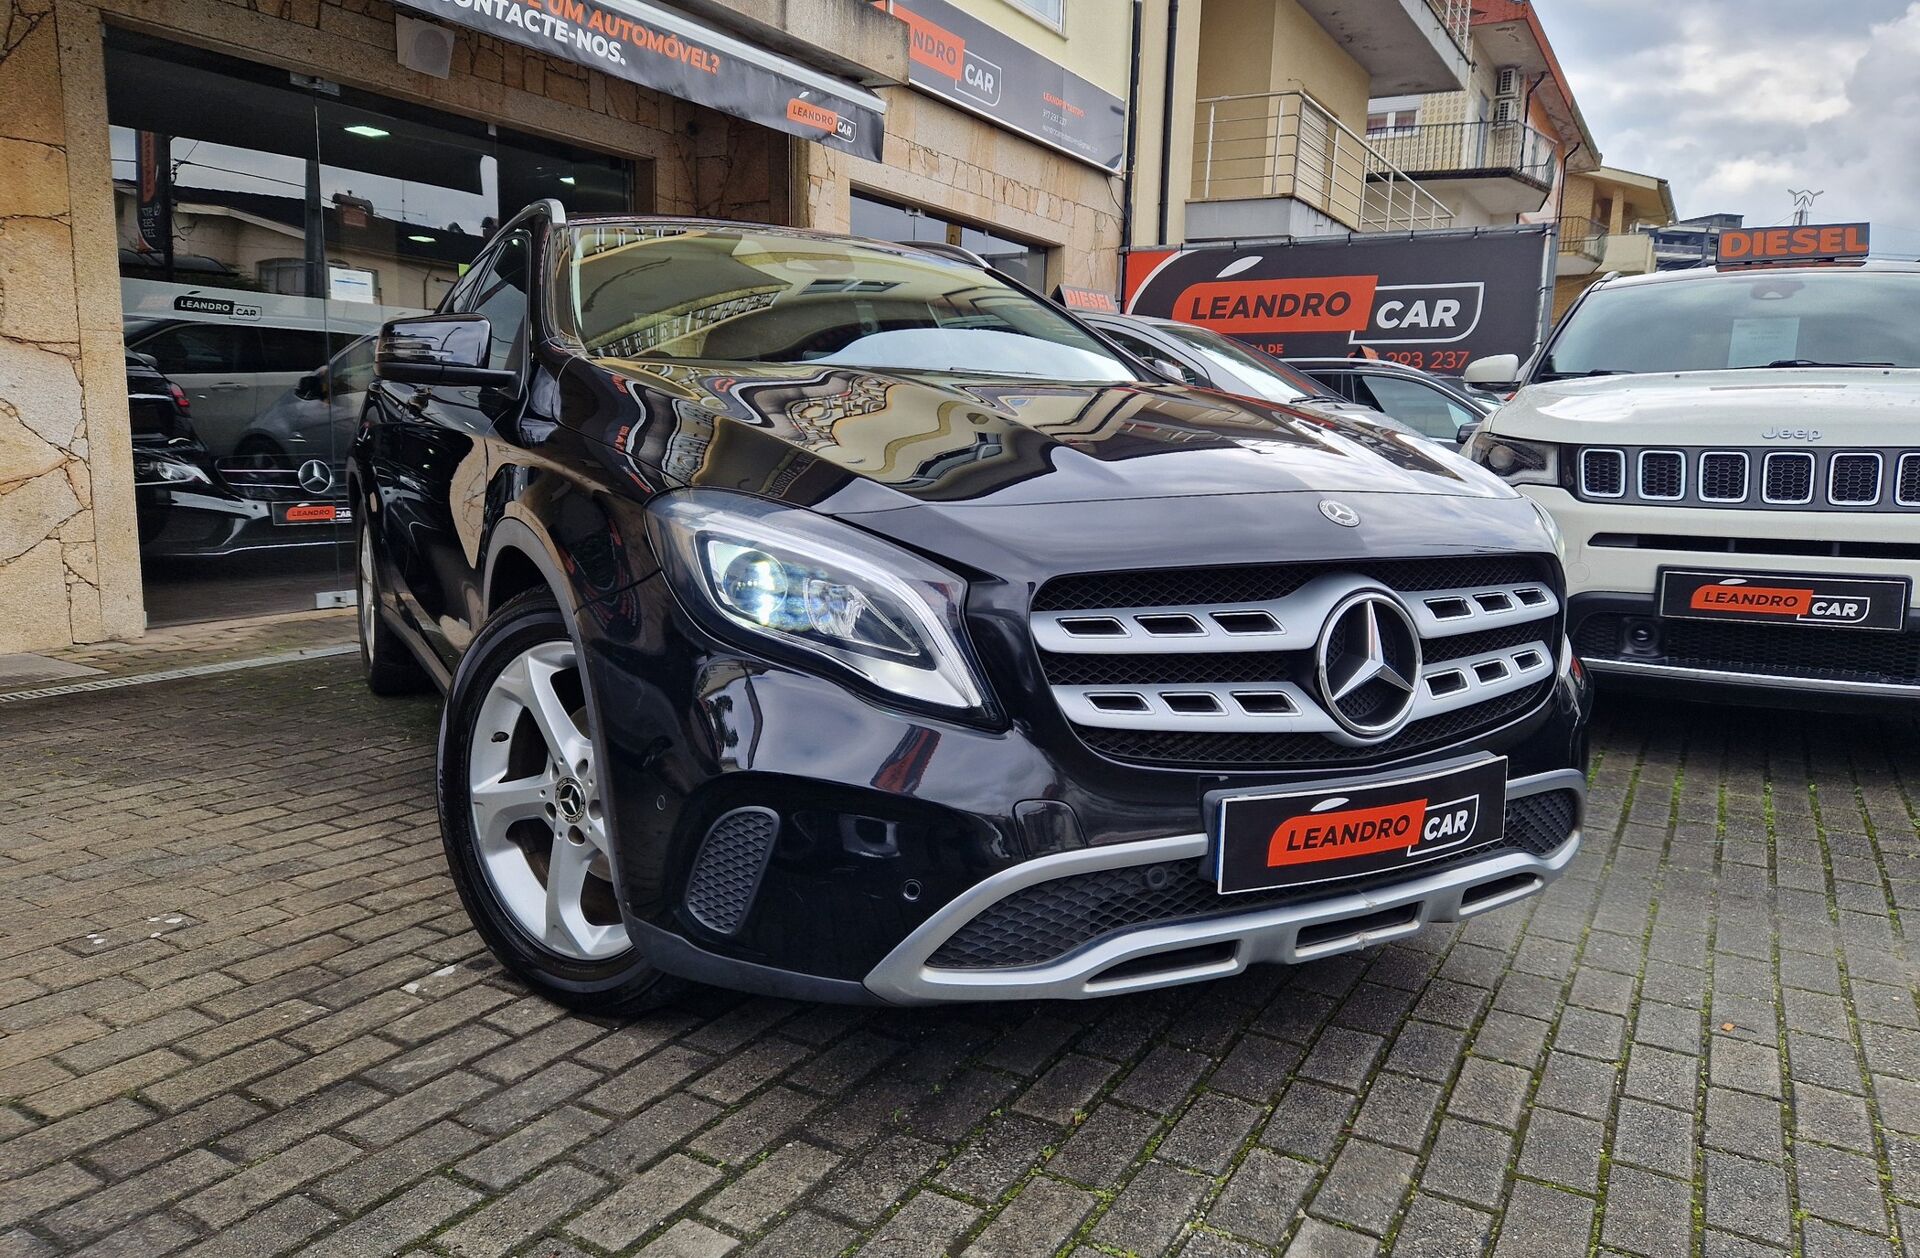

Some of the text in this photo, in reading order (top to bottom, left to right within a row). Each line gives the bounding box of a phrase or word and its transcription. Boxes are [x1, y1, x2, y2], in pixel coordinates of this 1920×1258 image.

[445, 0, 626, 65] NTACTE-NOS.
[548, 0, 721, 74] UM AUTOMÓVEL?
[964, 63, 995, 94] CAR
[792, 104, 852, 137] LEANDRO CAR
[1720, 227, 1869, 258] DIESEL
[180, 299, 257, 317] LEANDRO CAR
[1065, 288, 1116, 310] DIESEL
[1190, 291, 1461, 329] LEANDRO CAR
[1268, 343, 1284, 354] DE
[1430, 351, 1471, 369] 237
[1762, 427, 1822, 441] Jeep
[291, 508, 330, 517] LEANDRO
[1704, 591, 1859, 617] LEANDRO CAR
[1287, 809, 1469, 851] LEANDRO CAR
